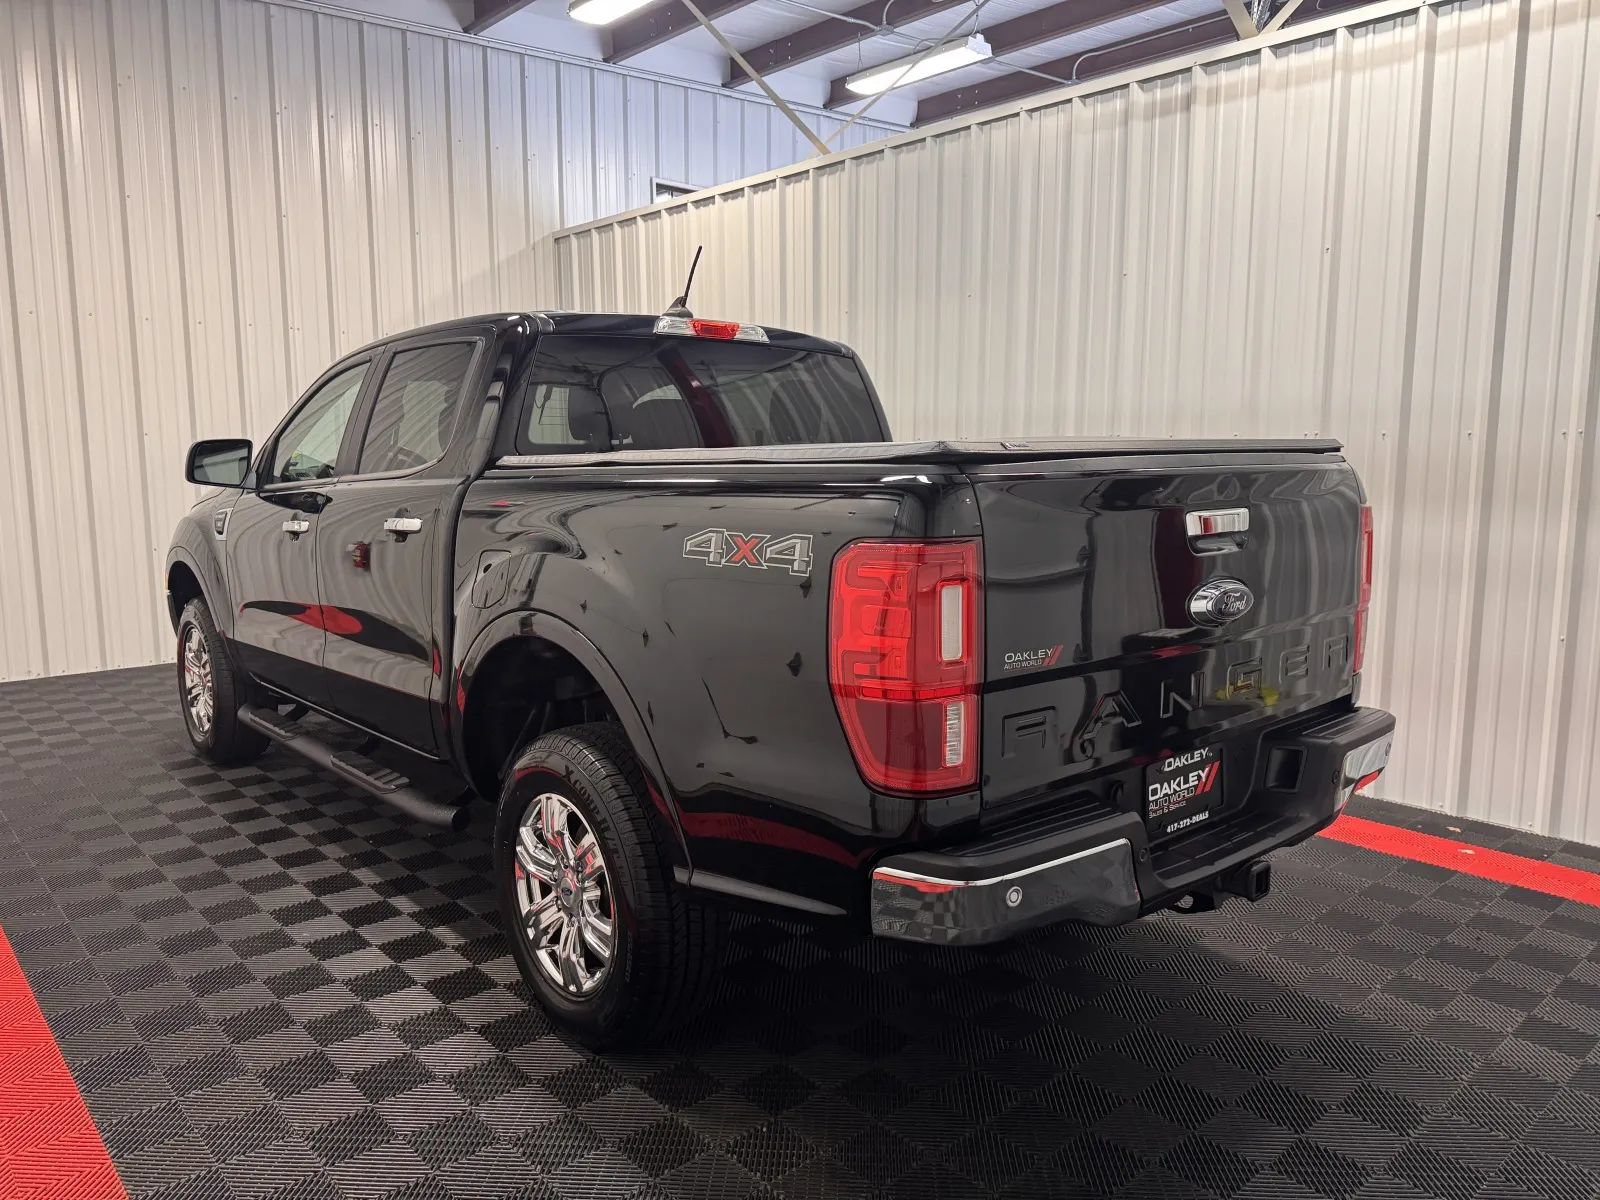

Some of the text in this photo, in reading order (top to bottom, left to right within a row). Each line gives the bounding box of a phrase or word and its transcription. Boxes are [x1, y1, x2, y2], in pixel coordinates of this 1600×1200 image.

[1222, 591, 1246, 612] Ford
[1004, 648, 1053, 663] OAKLEY
[1004, 659, 1042, 670] AUTO WORLD
[1001, 634, 1350, 758] RANGER
[1163, 747, 1209, 772] OAKLEY
[1148, 766, 1210, 801] OAKLEY
[1149, 787, 1195, 810] AUTO WORLD
